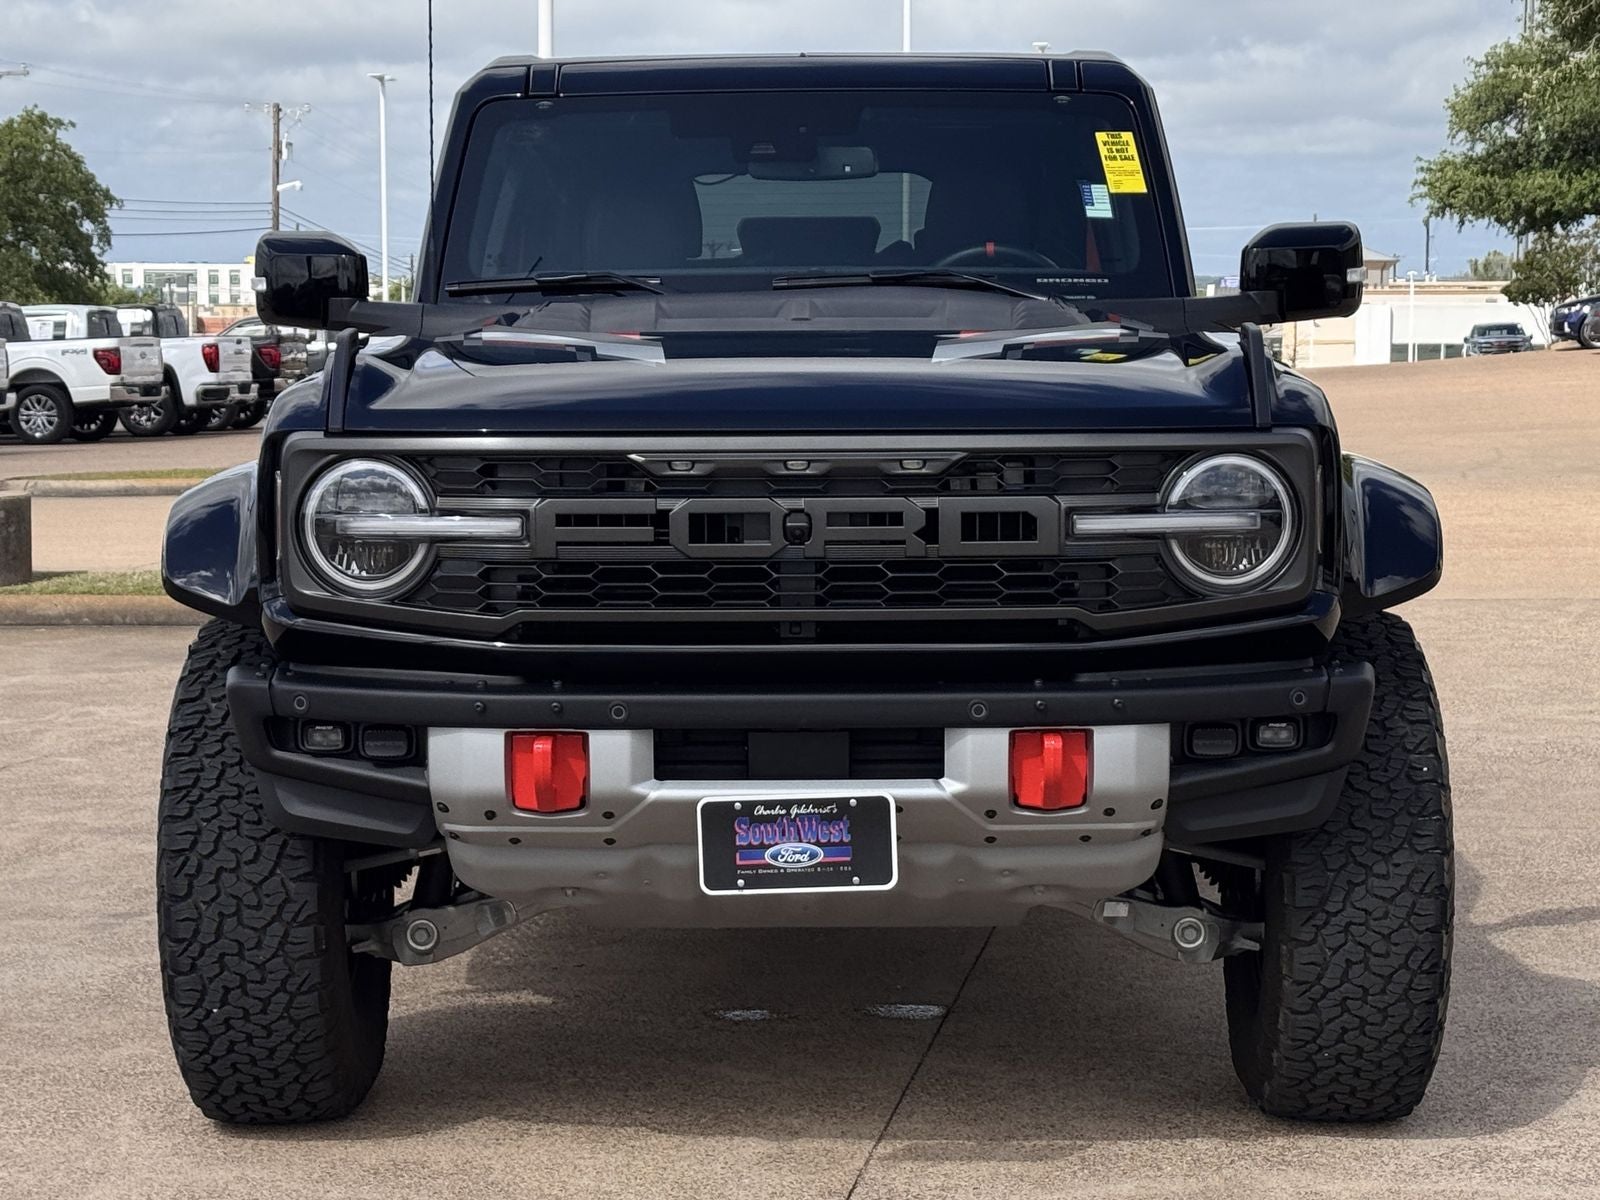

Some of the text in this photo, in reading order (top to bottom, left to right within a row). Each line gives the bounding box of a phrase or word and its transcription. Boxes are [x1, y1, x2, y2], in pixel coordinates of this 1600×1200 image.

[534, 496, 1061, 559] FORD
[753, 803, 838, 819] Charlie Gilchrist's
[777, 846, 811, 862] Ford
